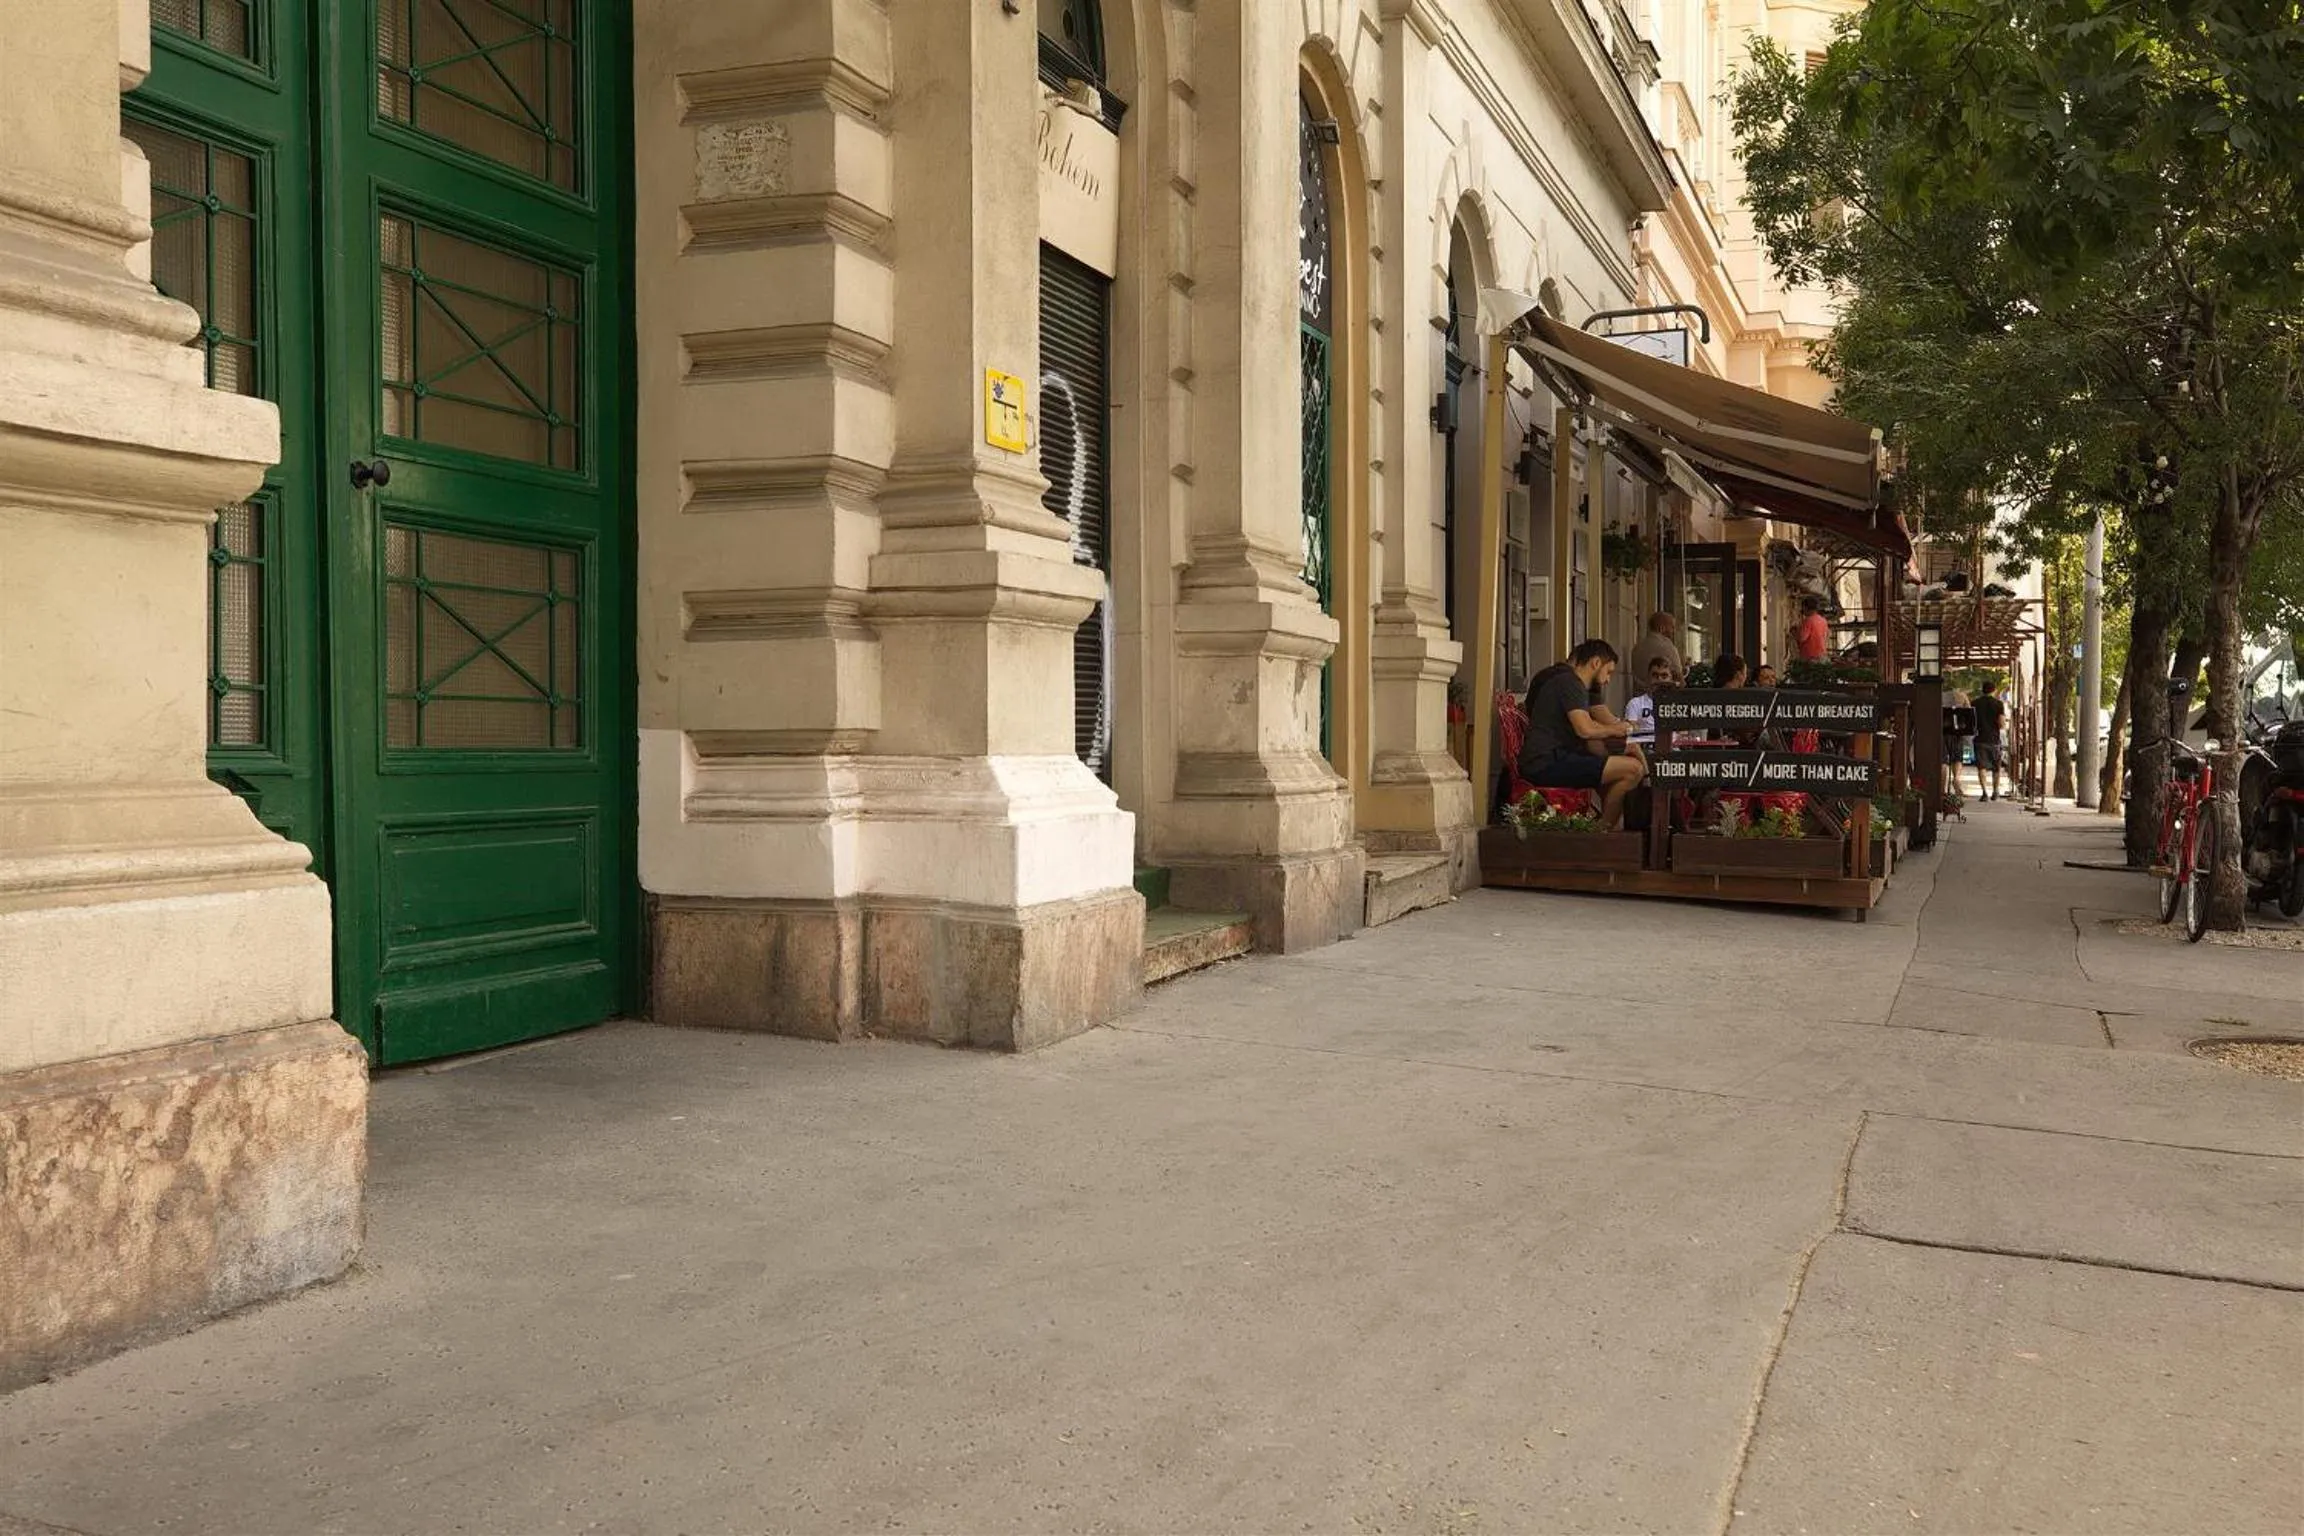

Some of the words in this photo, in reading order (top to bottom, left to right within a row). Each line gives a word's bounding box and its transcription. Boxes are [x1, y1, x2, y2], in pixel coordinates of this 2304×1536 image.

[1658, 703, 1689, 718] EGÉSZ
[1690, 704, 1723, 718] NAPOS
[1725, 704, 1764, 719] REGGELI
[1775, 705, 1793, 718] ALL
[1795, 705, 1816, 718] DAY
[1817, 704, 1875, 719] BREAKFAST
[1655, 760, 1686, 777] TÖBB
[1689, 763, 1719, 778] MINT
[1721, 761, 1749, 778] SÜTI
[1762, 764, 1798, 779] MORE
[1800, 764, 1834, 780] THAN
[1836, 766, 1869, 781] CAKE
